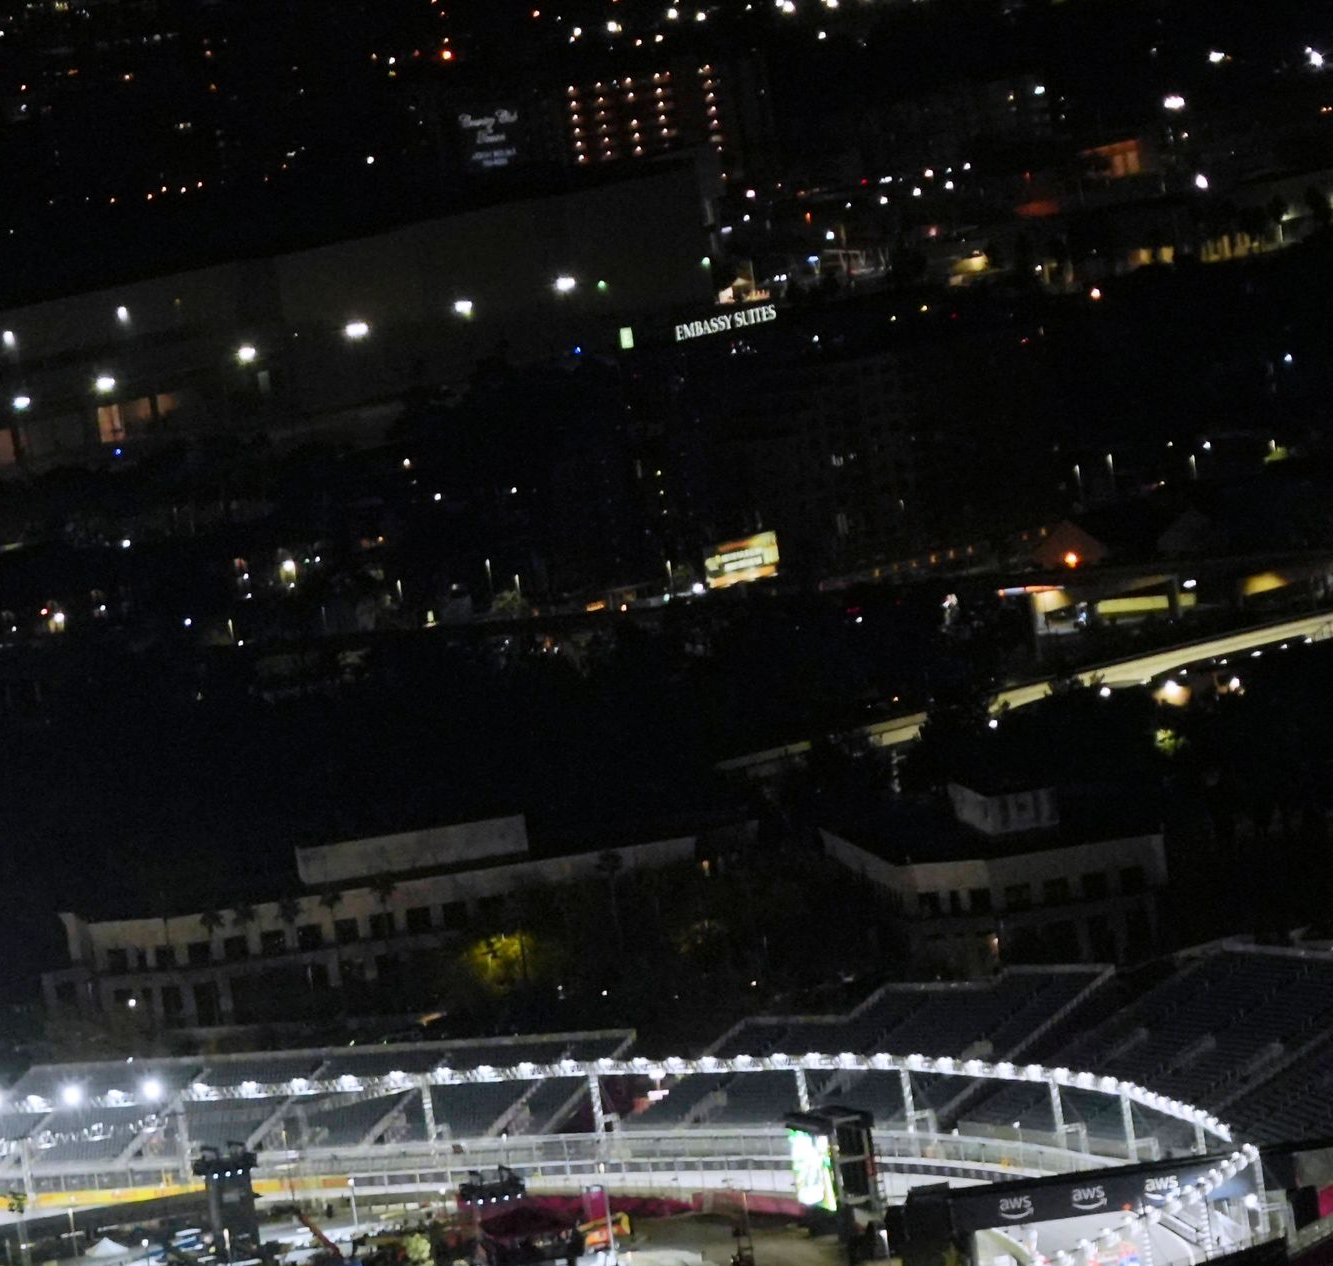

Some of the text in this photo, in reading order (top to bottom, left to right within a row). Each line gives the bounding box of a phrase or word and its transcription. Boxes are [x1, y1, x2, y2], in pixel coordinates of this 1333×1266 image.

[675, 304, 777, 342] EMBASSY SUITES
[1144, 1175, 1180, 1193] aws
[1071, 1185, 1106, 1201] aws
[998, 1195, 1033, 1211] aws
